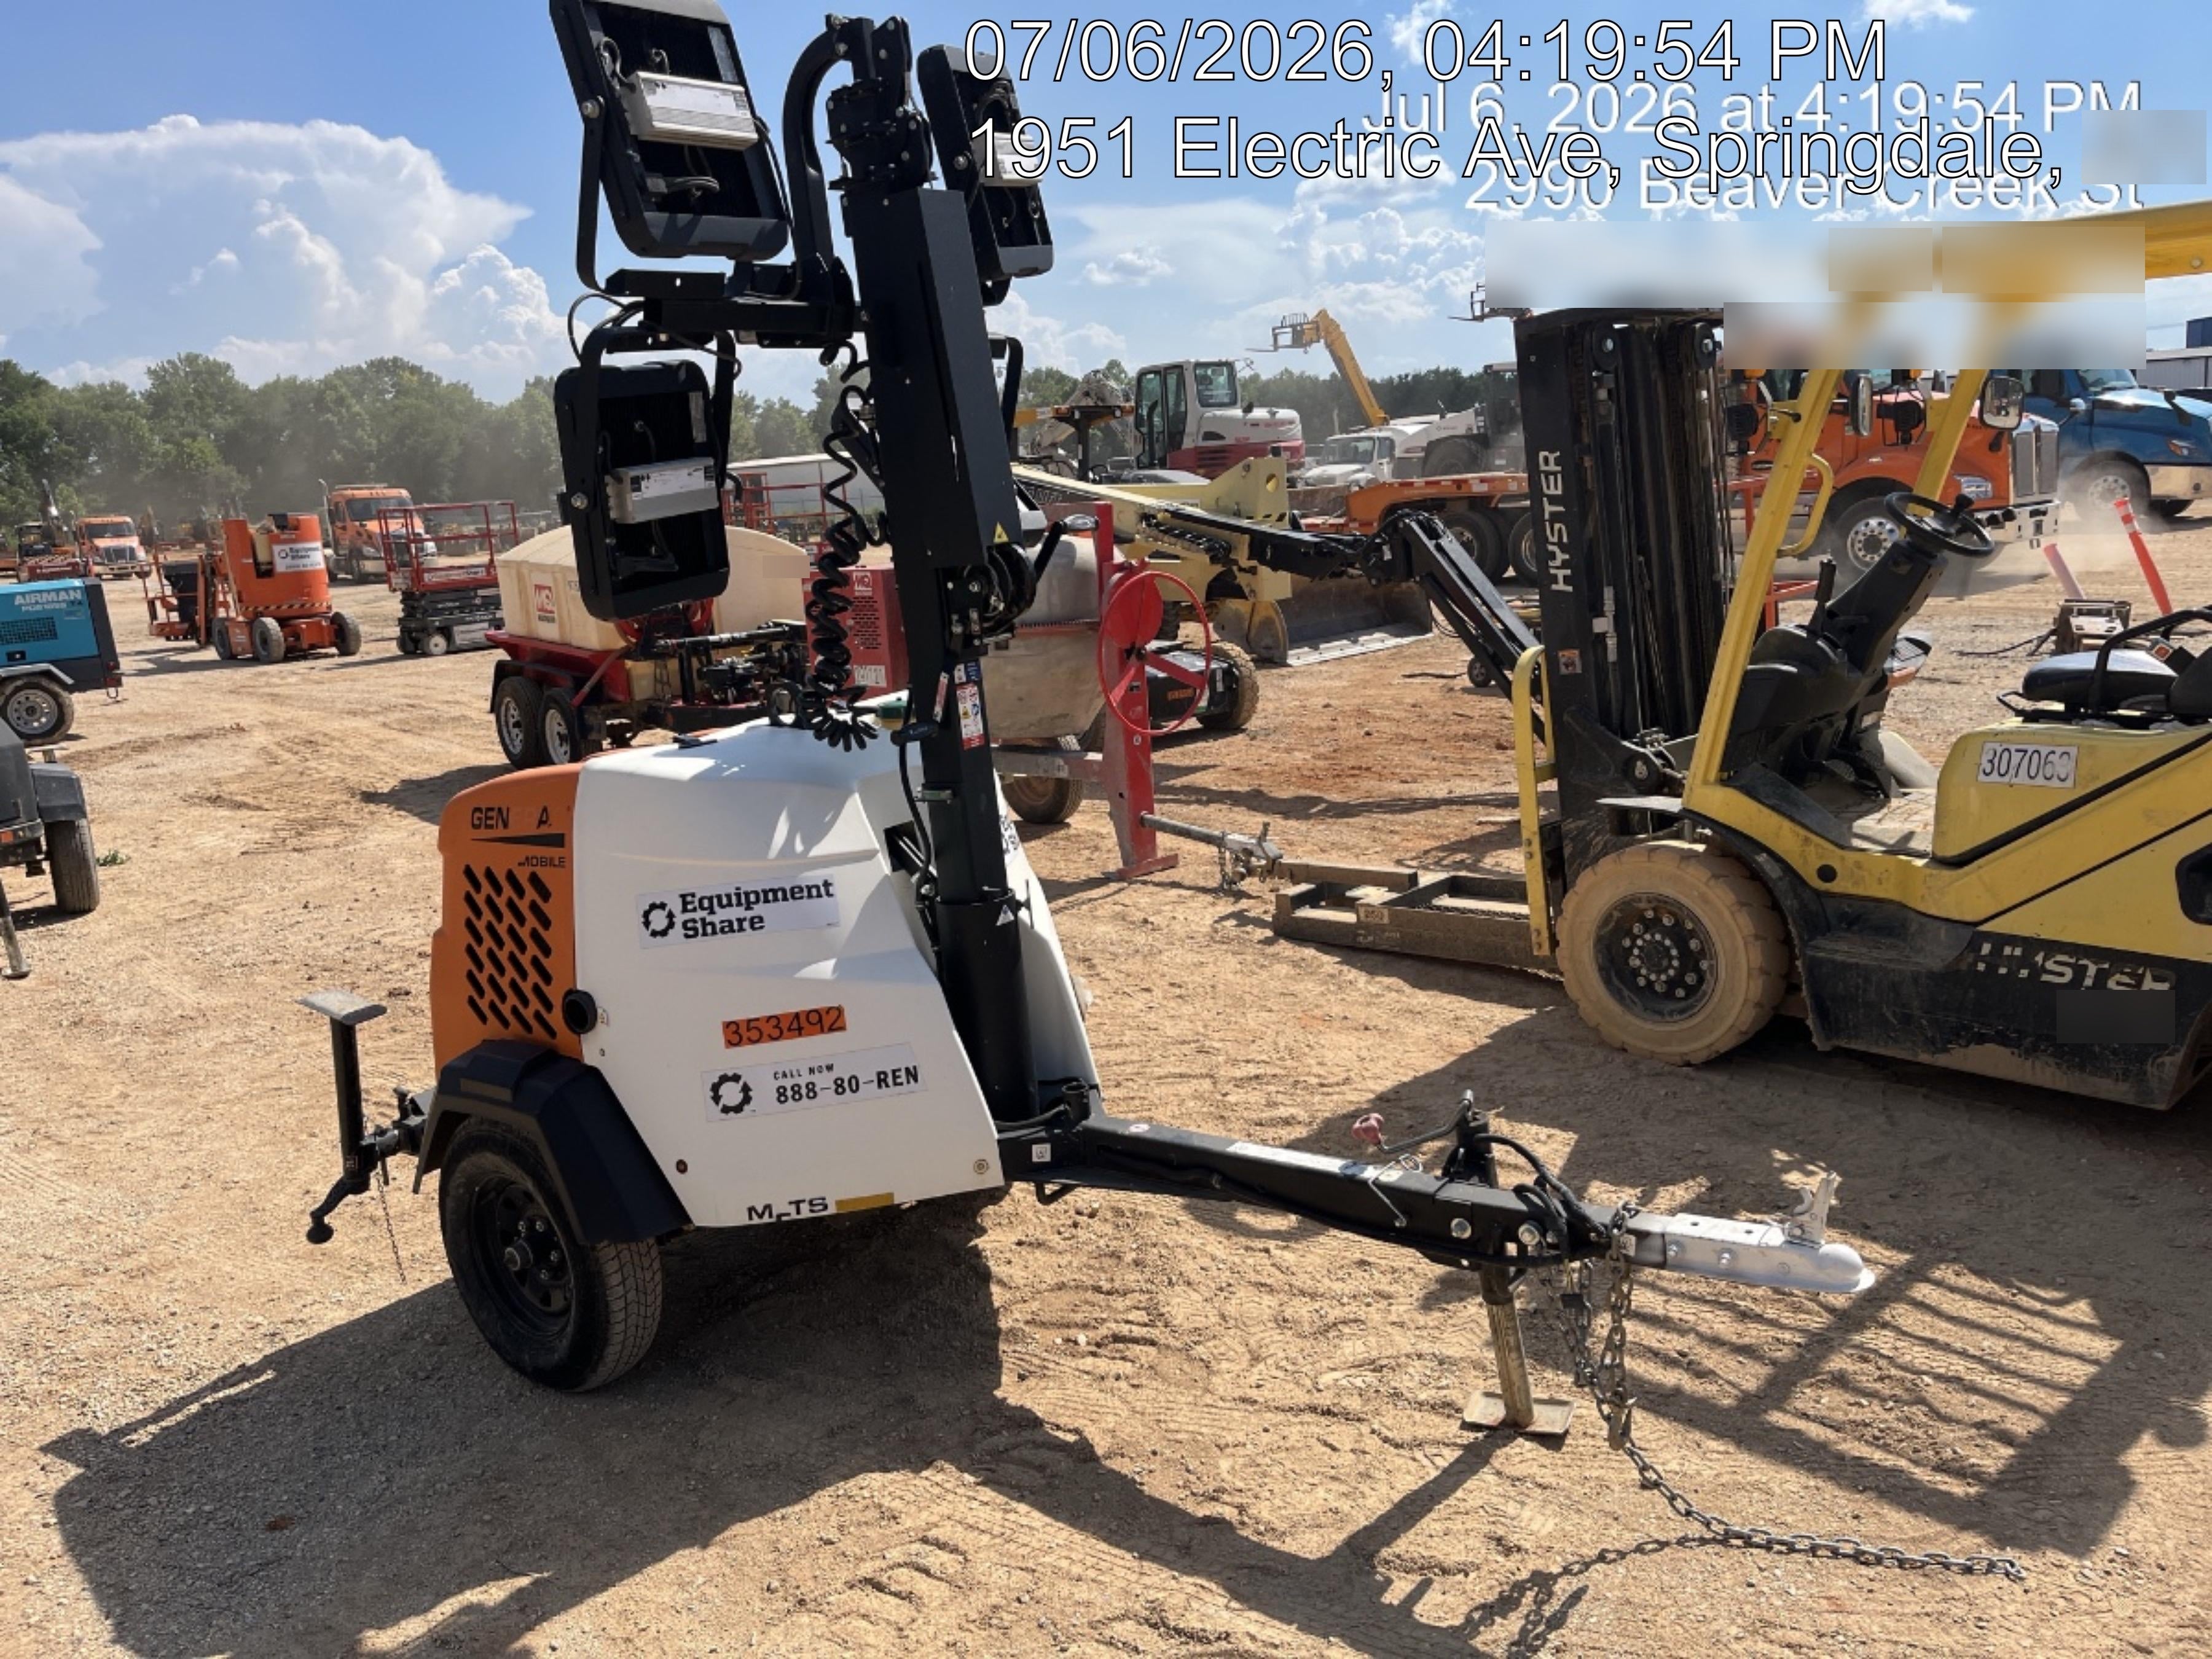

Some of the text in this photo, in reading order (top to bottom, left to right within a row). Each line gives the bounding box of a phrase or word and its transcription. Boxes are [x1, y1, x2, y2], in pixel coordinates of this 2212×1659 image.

[1538, 451, 1573, 592] HYSTER
[14, 589, 82, 605] AIRMAN
[679, 879, 834, 916] Equipment
[681, 914, 766, 939] Share
[725, 1006, 845, 1047] 353492
[773, 1063, 834, 1081] CALL NOW
[775, 1065, 919, 1105] 888-80-REN
